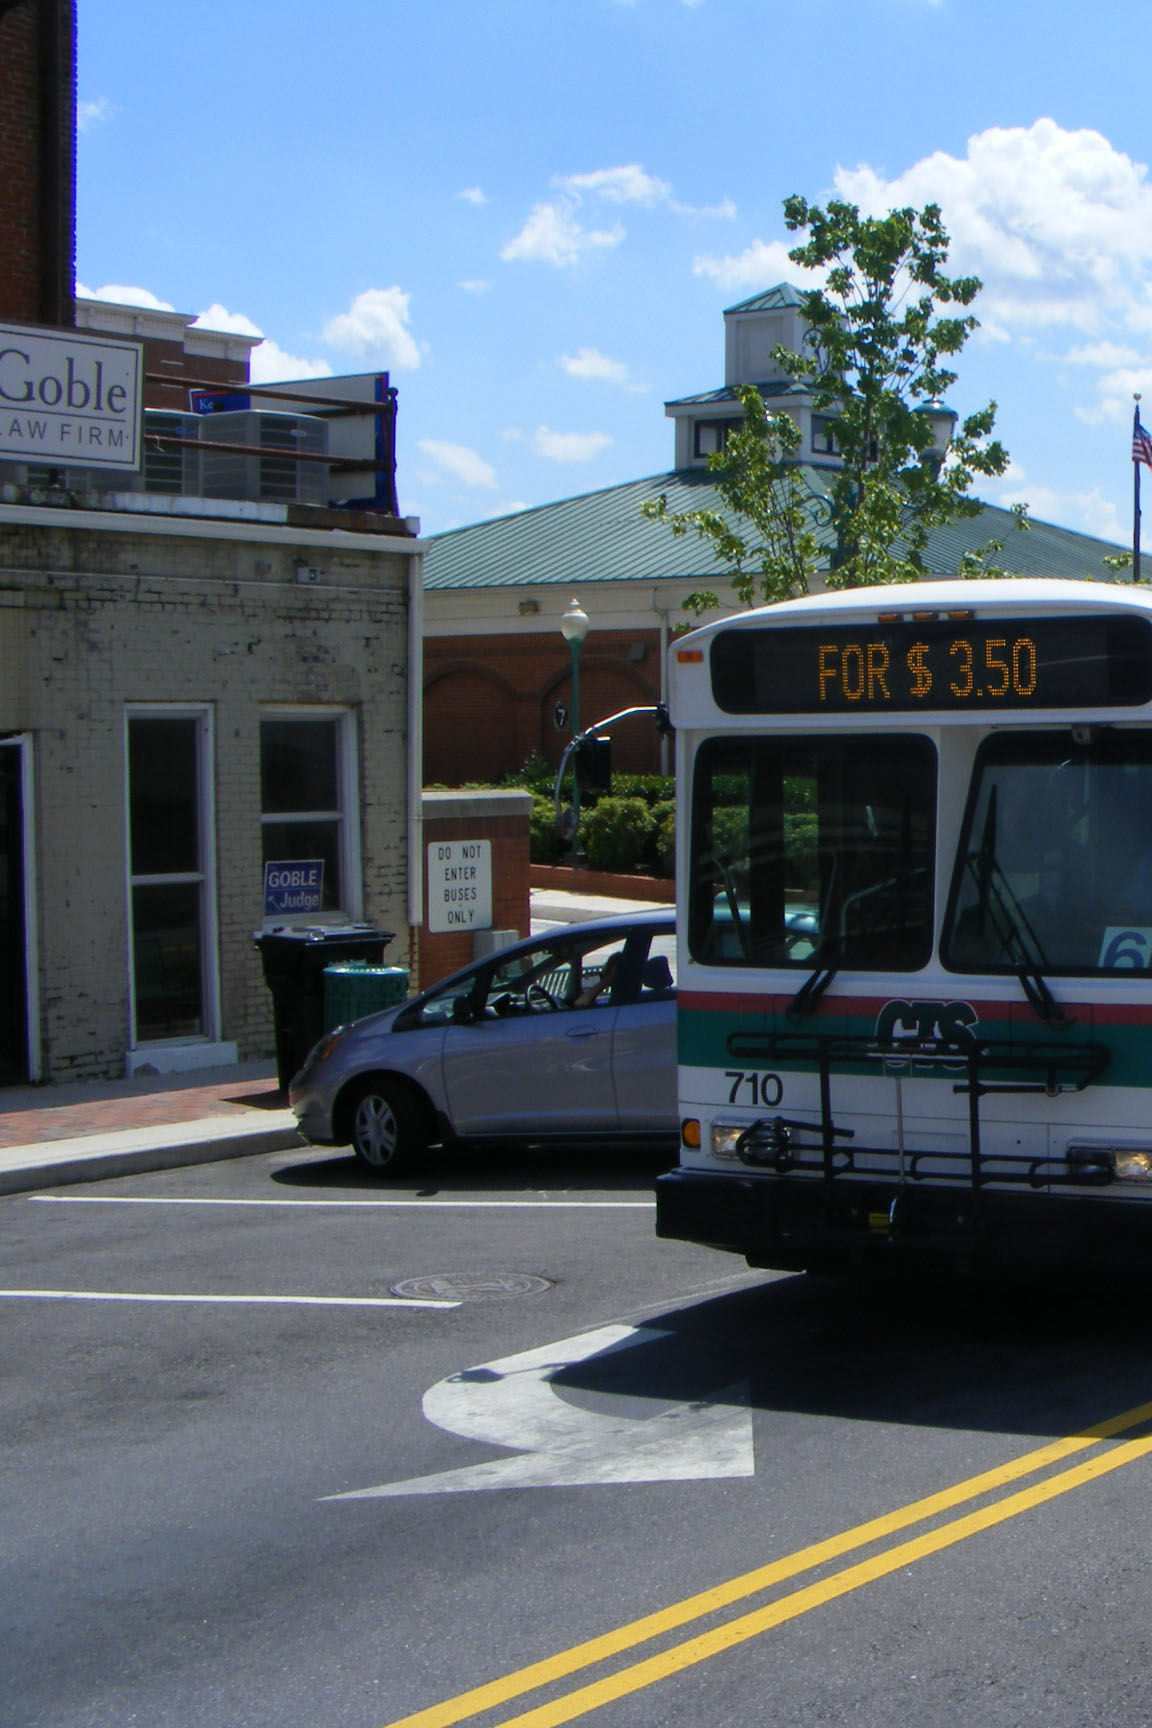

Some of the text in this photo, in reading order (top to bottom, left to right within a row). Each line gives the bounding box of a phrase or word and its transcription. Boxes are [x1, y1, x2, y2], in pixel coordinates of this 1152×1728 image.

[0, 349, 127, 413] Goble
[0, 418, 123, 448] AW FIRM
[819, 638, 1037, 700] FOR $ 3.50
[438, 845, 481, 861] DO NOT
[268, 870, 318, 888] GOBLE
[445, 867, 477, 881] ENTER
[280, 892, 320, 912] Judge
[444, 888, 477, 902] BUSES
[447, 909, 475, 924] ONLY
[1103, 930, 1147, 968] 6
[725, 1071, 783, 1107] 710
